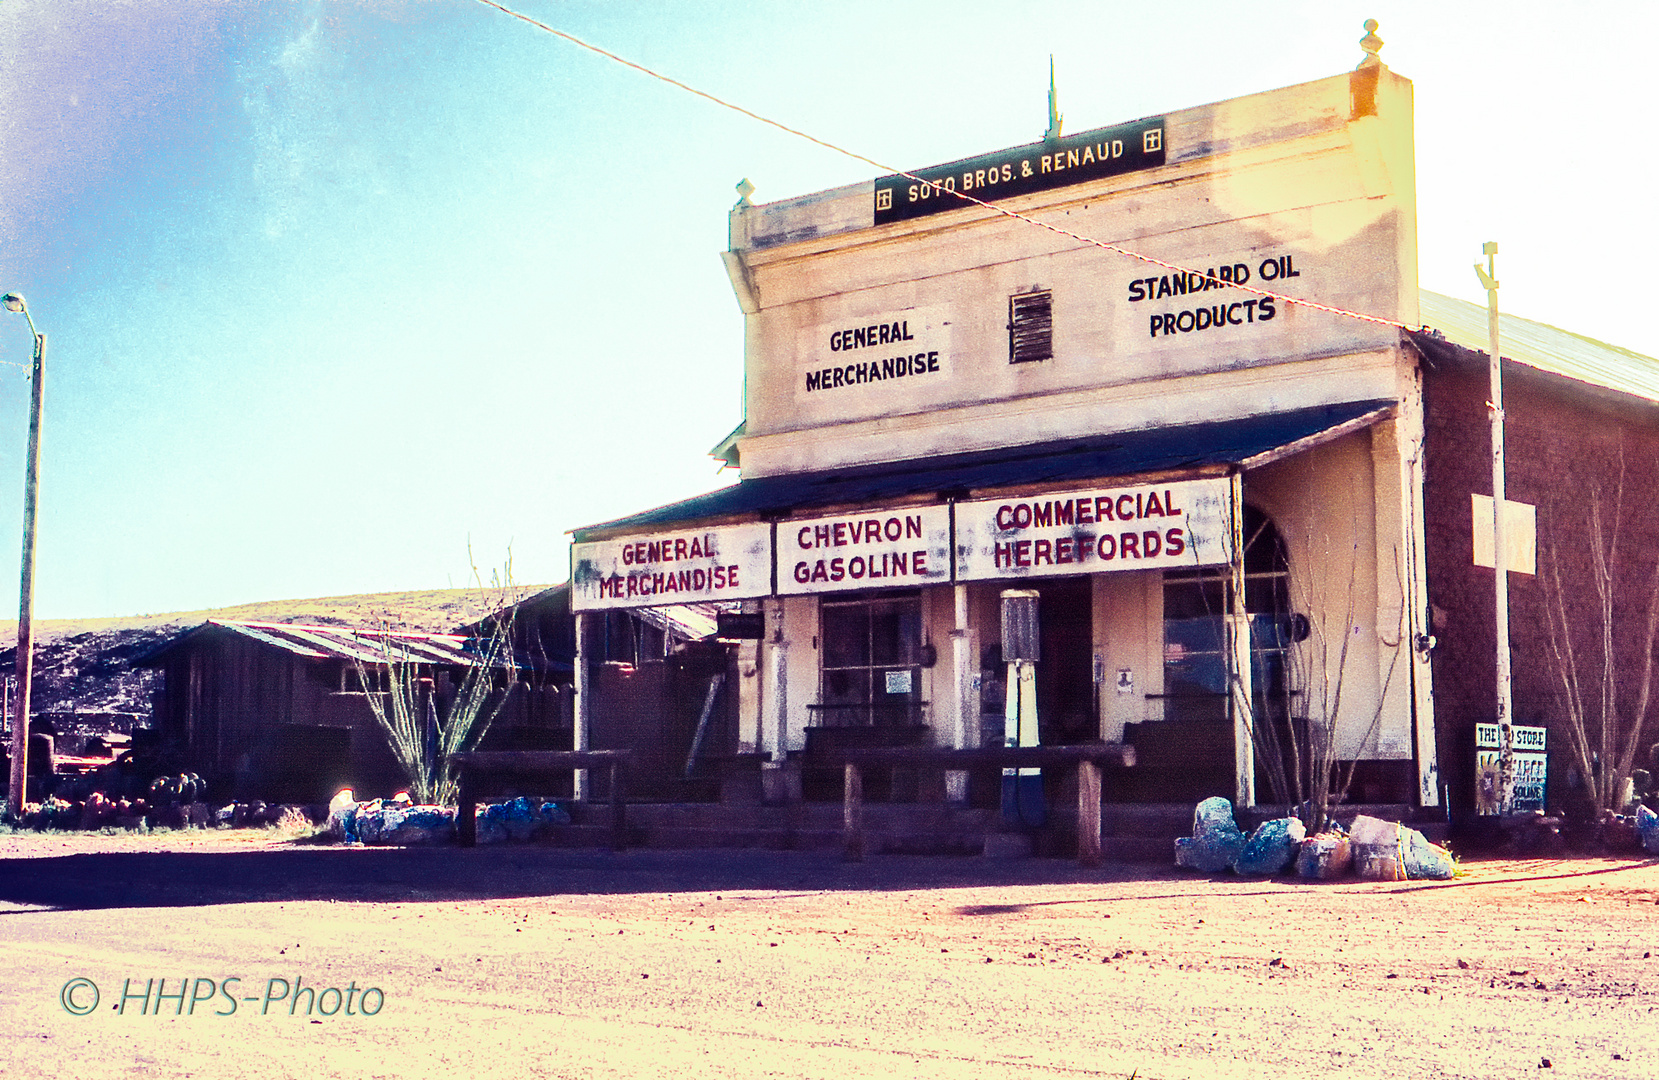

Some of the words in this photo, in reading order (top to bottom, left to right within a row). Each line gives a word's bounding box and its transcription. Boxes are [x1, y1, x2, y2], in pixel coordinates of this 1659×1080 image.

[908, 176, 955, 202] SOTO
[963, 164, 1017, 190] BROS.
[1021, 160, 1034, 177] &
[1041, 140, 1123, 174] RENAUD
[1128, 263, 1250, 302] STANDARD
[1259, 255, 1300, 281] OIL
[830, 320, 914, 352] GENERAL
[1150, 297, 1276, 338] PRODUCTS
[805, 351, 940, 392] MERCHANDISE
[996, 490, 1182, 531] COMMERCIAL
[622, 535, 715, 566] GENERAL
[797, 515, 922, 550] CHEVRON
[995, 528, 1185, 568] HEREFORDS
[600, 564, 739, 599] MERCHANDISE
[794, 550, 927, 584] GASOLINE
[1478, 727, 1496, 742] THE
[1516, 730, 1544, 746] STORE
